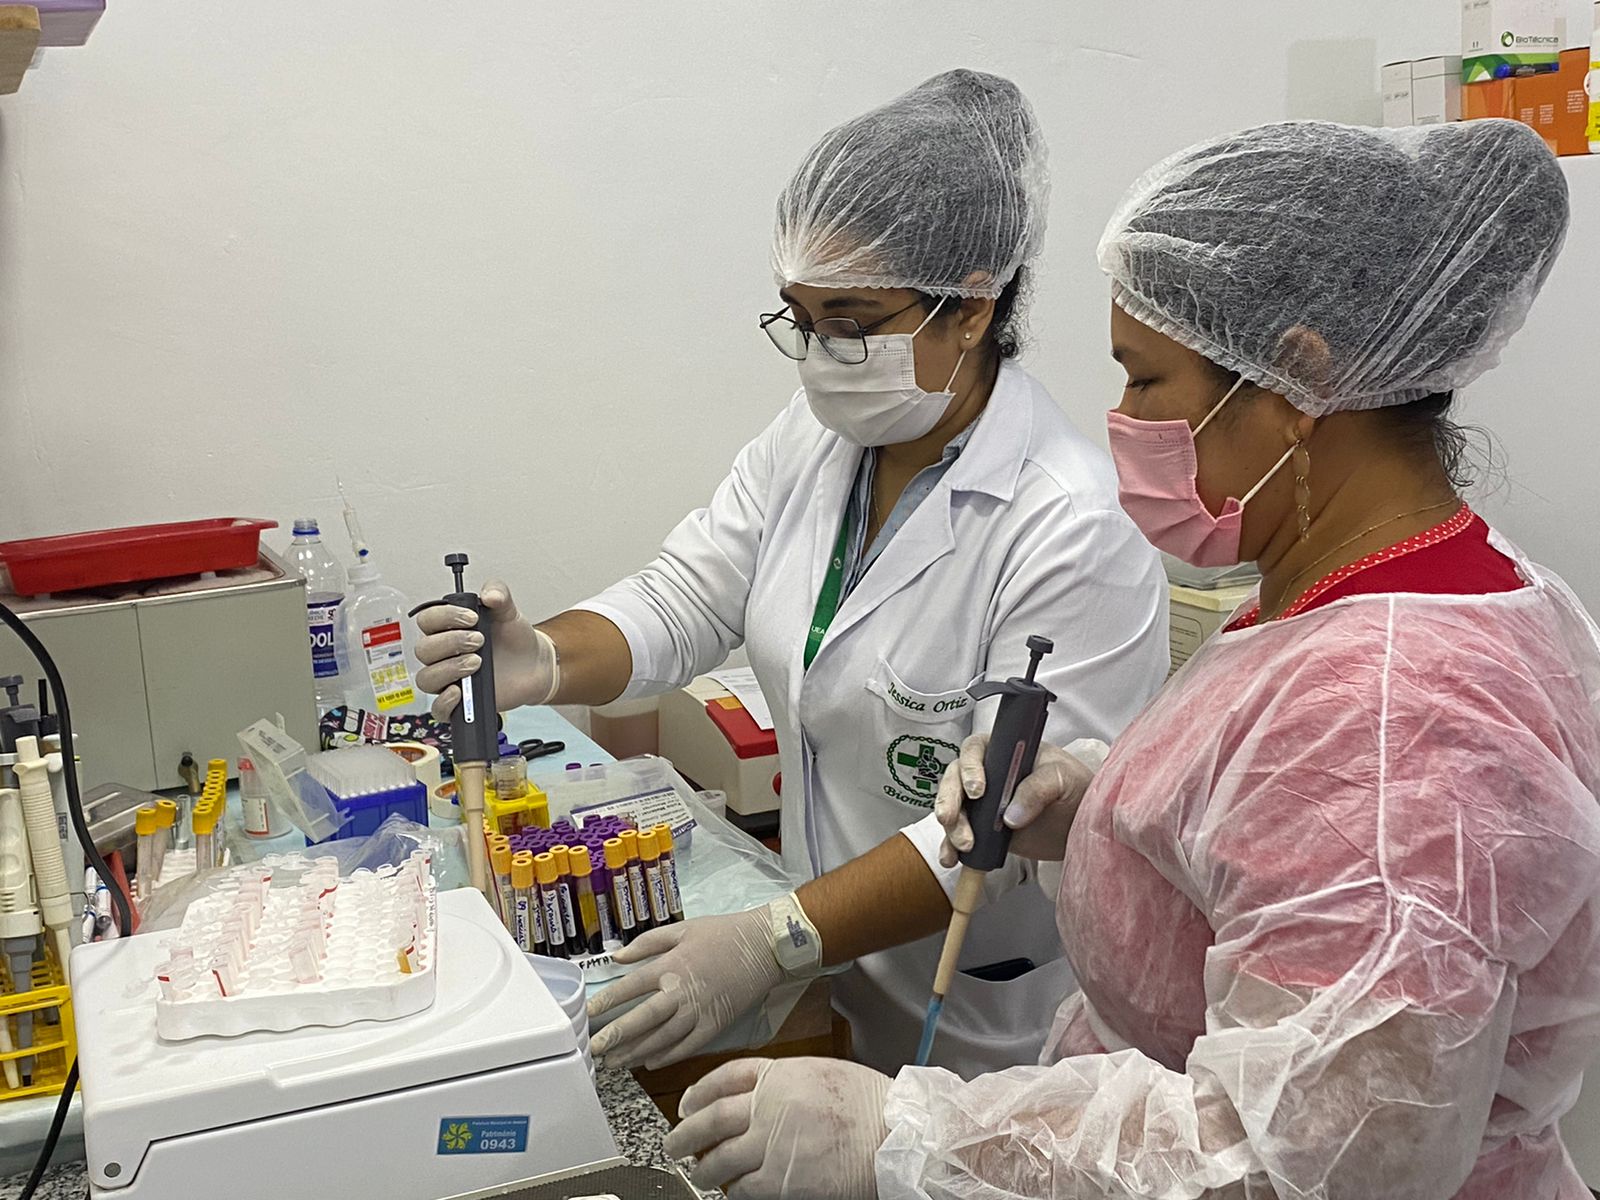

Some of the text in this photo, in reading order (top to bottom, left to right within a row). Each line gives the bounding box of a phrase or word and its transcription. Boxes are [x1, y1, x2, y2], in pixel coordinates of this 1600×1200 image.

[887, 681, 968, 713] Jessica Ortiz
[480, 1138, 516, 1150] 0943
